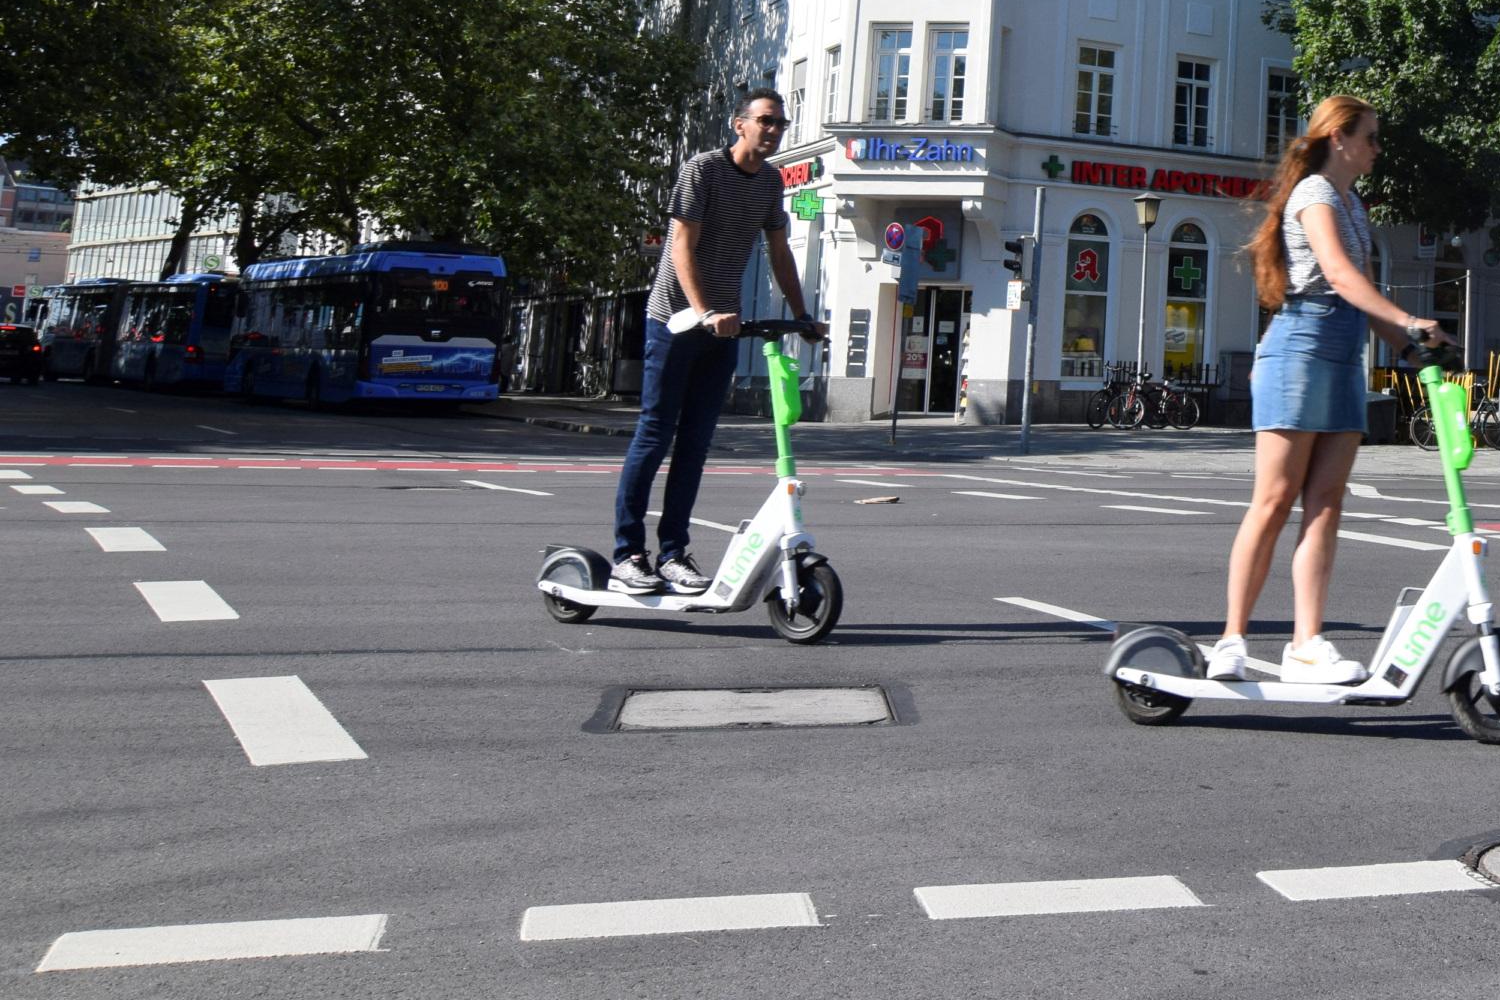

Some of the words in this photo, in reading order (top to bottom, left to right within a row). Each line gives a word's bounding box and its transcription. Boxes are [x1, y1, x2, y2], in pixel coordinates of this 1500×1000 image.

[868, 137, 973, 162] Ihr-Zahn
[1071, 160, 1147, 188] INTER
[723, 533, 763, 584] Lime
[1395, 602, 1446, 667] Lime
